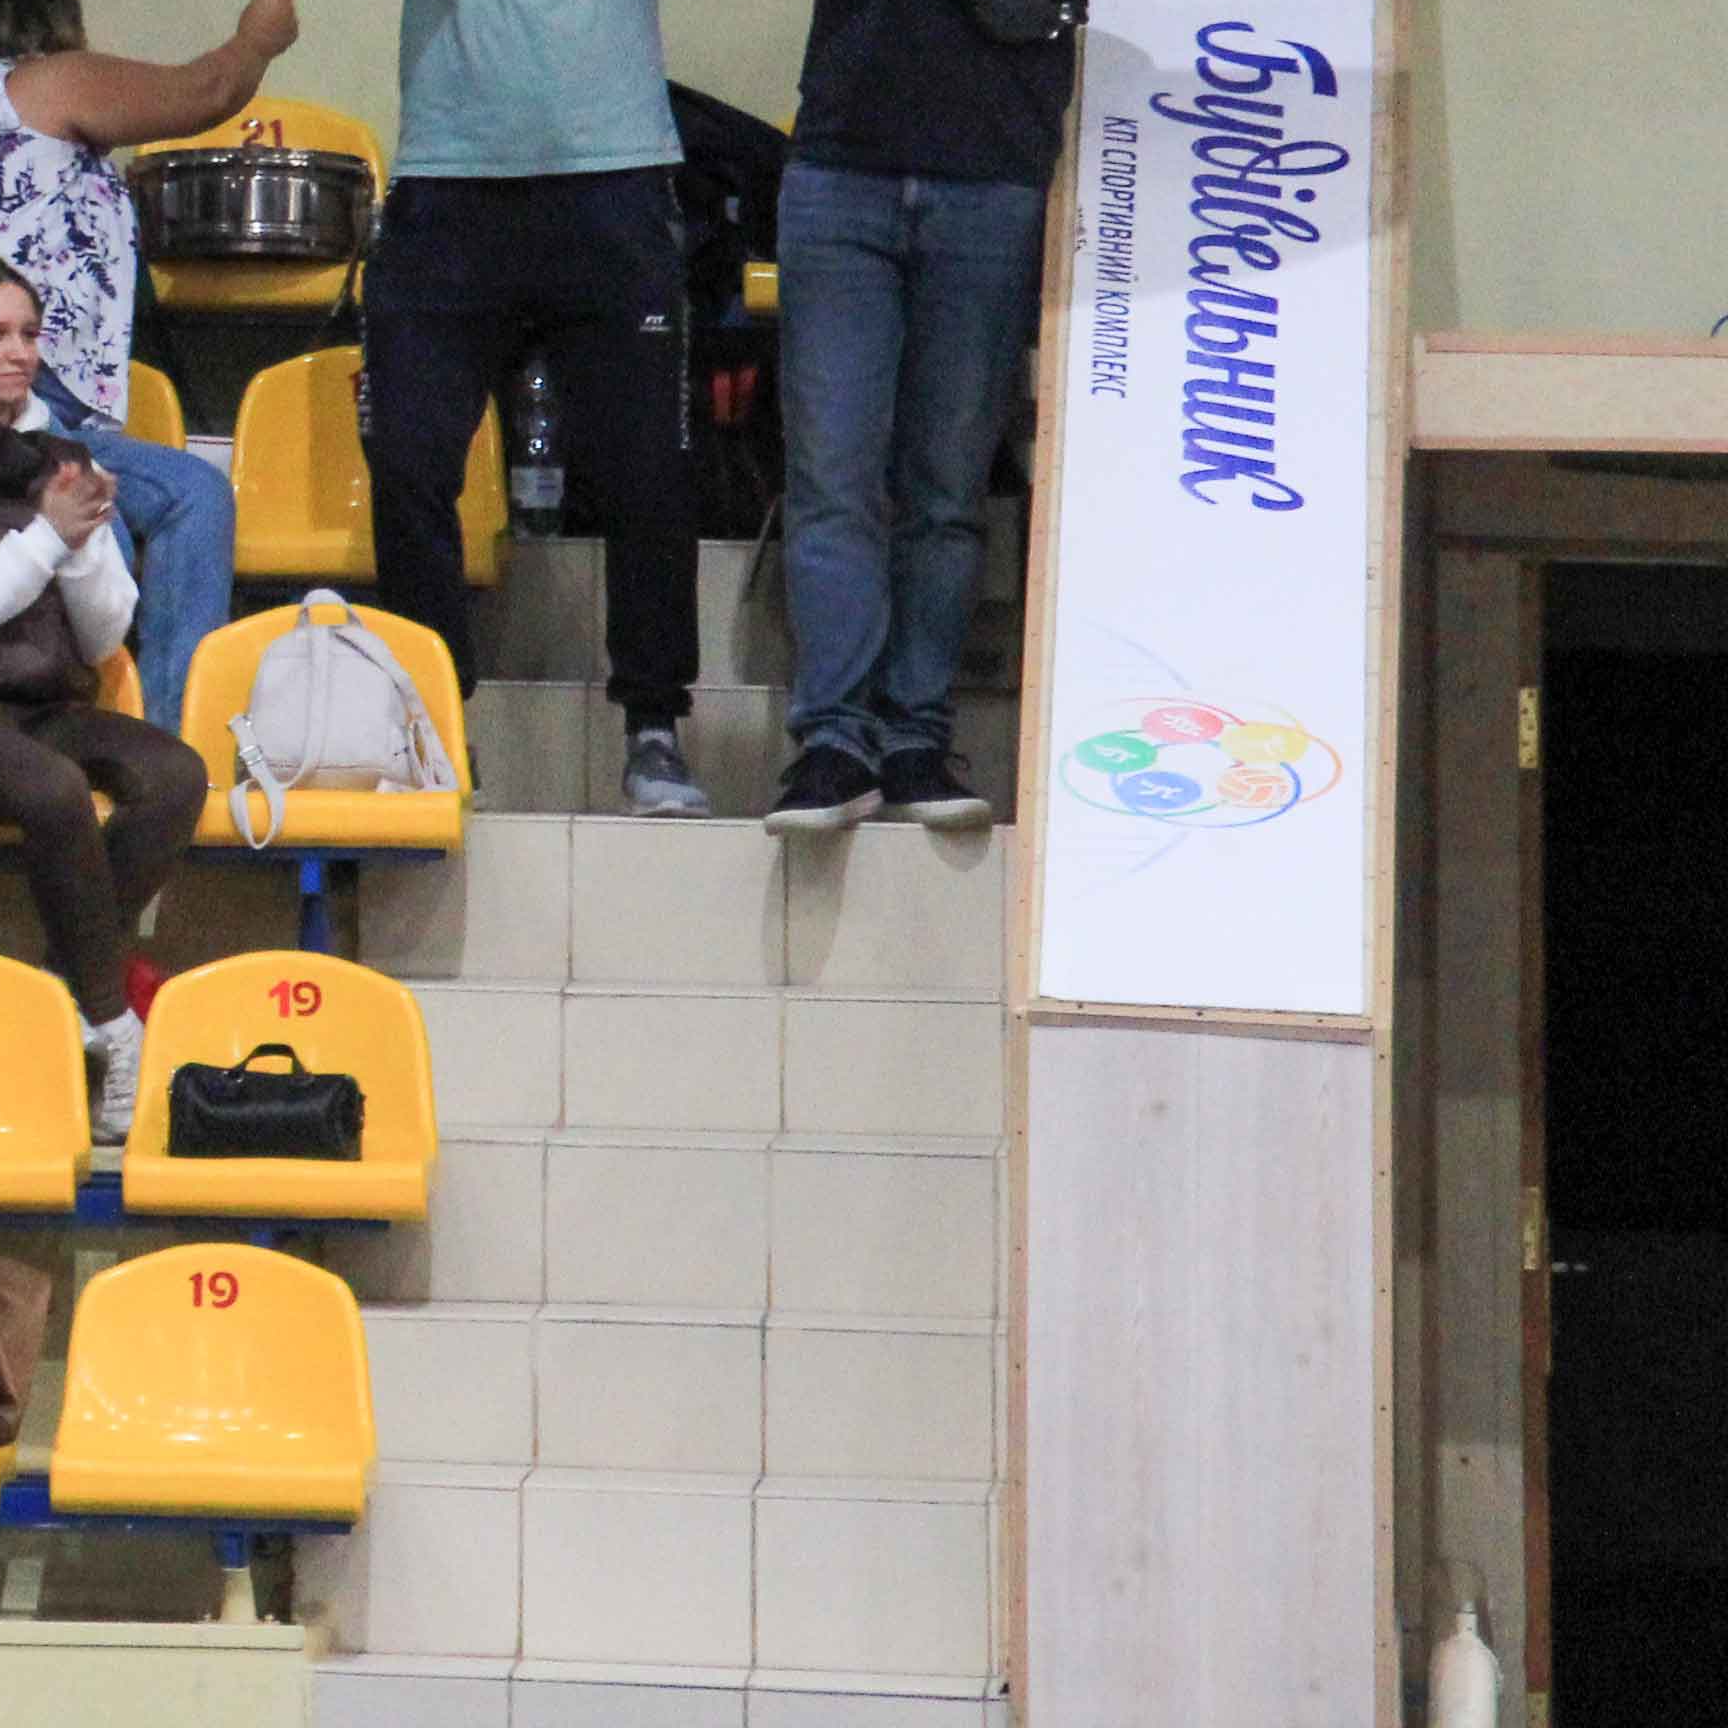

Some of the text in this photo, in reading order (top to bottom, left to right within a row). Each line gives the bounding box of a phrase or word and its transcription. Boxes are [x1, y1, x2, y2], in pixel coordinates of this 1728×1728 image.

[239, 119, 284, 149] 21
[1090, 116, 1140, 399] КП СПОРТИВНИЙ КОМПЛЕКС
[1150, 19, 1351, 512] Будівельник
[269, 980, 322, 1018] 19
[189, 1271, 239, 1309] 19
